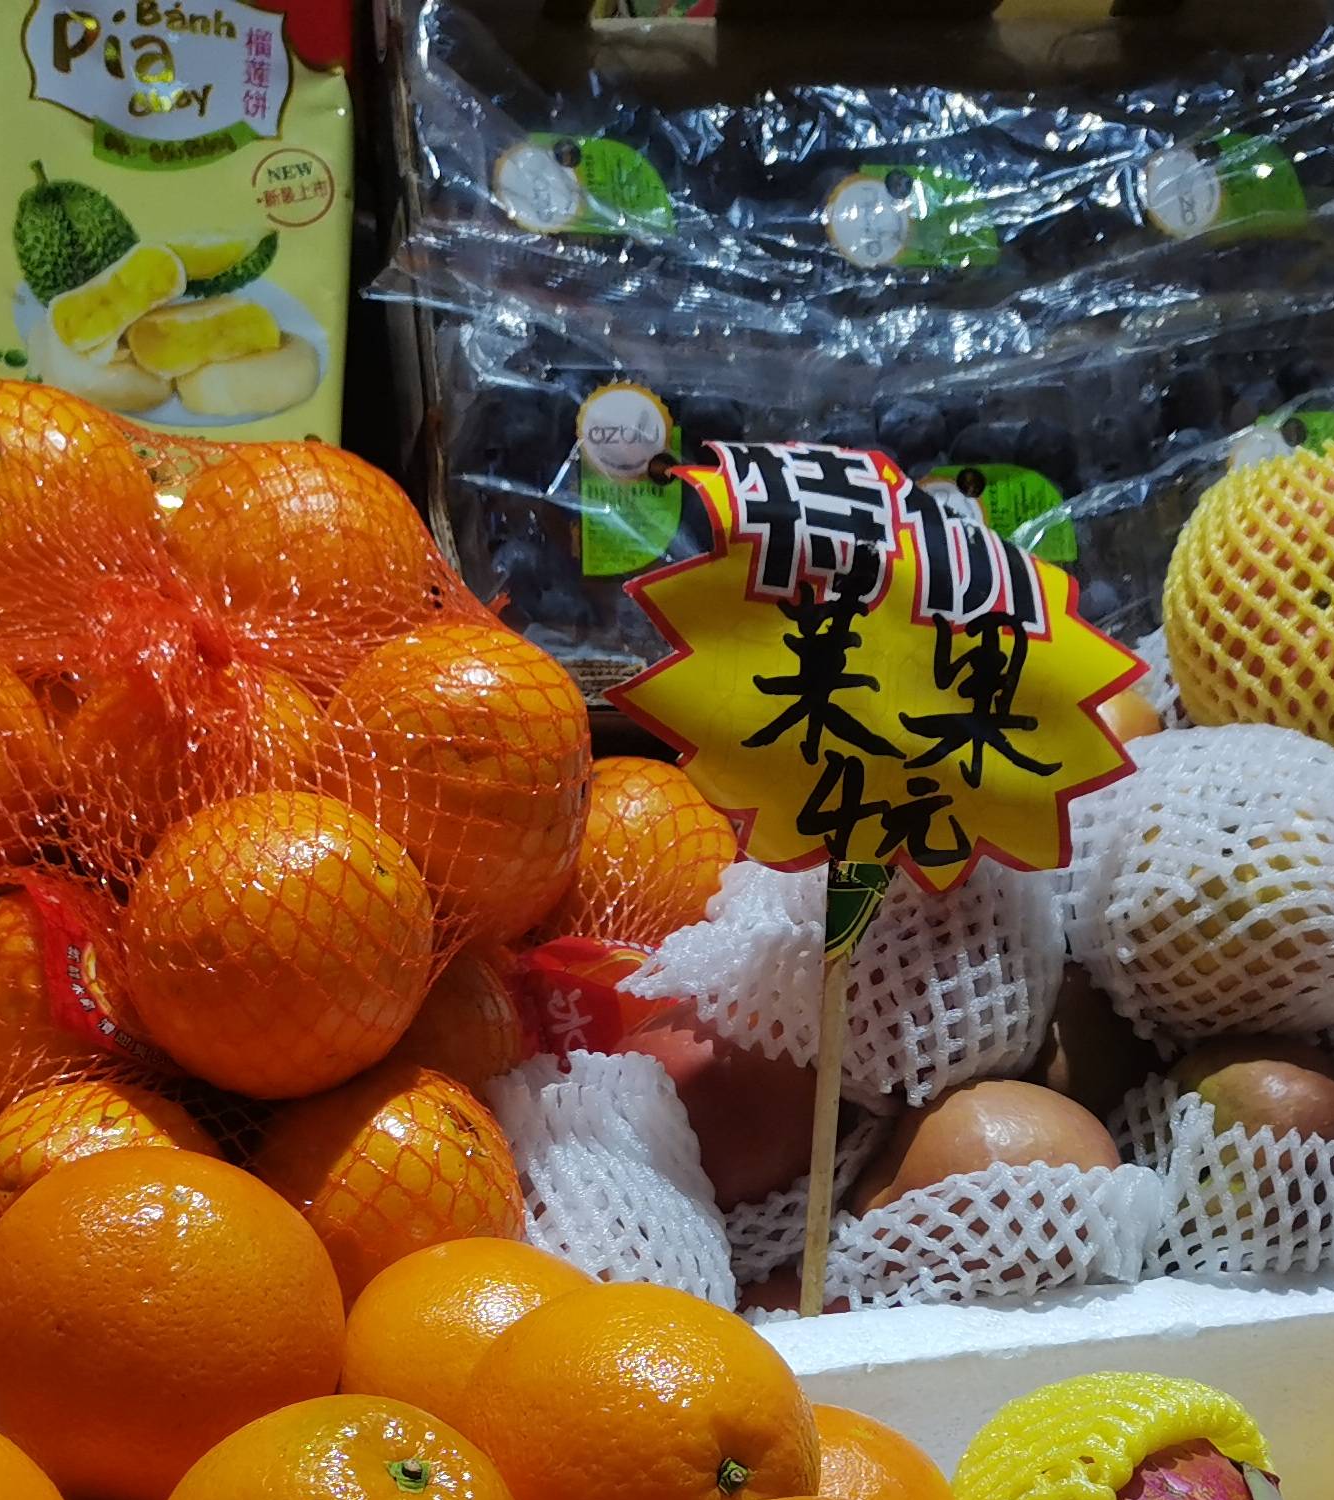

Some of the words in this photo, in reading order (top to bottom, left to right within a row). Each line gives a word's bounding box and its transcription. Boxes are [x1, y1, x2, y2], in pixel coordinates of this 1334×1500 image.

[267, 160, 315, 184] NEW
[727, 441, 1047, 630] 特价
[795, 749, 973, 867] 4元
